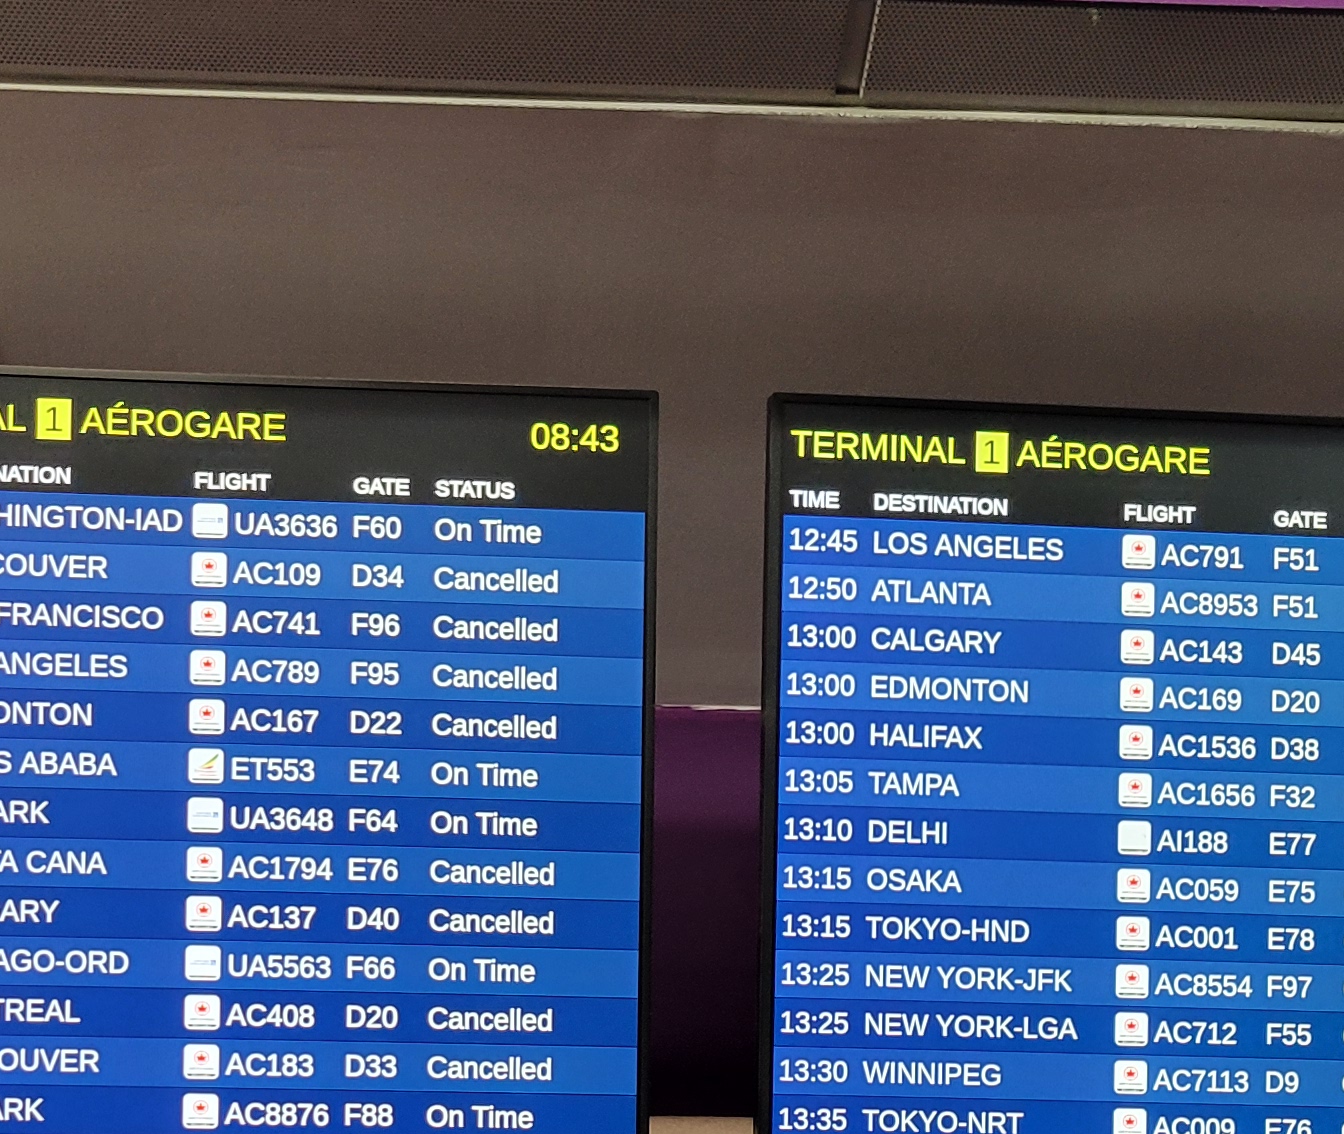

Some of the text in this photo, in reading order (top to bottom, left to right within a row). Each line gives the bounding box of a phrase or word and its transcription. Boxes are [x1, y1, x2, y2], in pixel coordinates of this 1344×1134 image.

[79, 402, 286, 441] AÉROGARE
[531, 423, 619, 452] 08:43
[791, 430, 966, 464] TERMINAL
[1016, 435, 1210, 474] AÉROGARE
[194, 472, 271, 491] FLIGHT
[353, 477, 410, 496] GATE
[435, 479, 515, 499] STATUS
[789, 489, 840, 509] TIME
[874, 493, 1008, 516] DESTINATION
[1124, 504, 1196, 523] FLIGHT
[1274, 510, 1327, 529] GATE
[233, 561, 320, 586] AC109
[352, 564, 404, 588] D34
[434, 567, 558, 593] Cancelled
[789, 576, 857, 600] 12:50
[871, 579, 991, 606] ATLANTA
[1160, 592, 1258, 616] AC8953
[1274, 595, 1318, 618] F51
[19, 751, 117, 776] ABABA
[231, 757, 315, 781] ET553
[350, 760, 400, 783] E74
[431, 762, 468, 785] On
[476, 763, 538, 787] Time
[785, 818, 852, 841] 13:10
[869, 820, 947, 844] DELHI
[1157, 830, 1227, 853] AI188
[1270, 833, 1316, 855] E77
